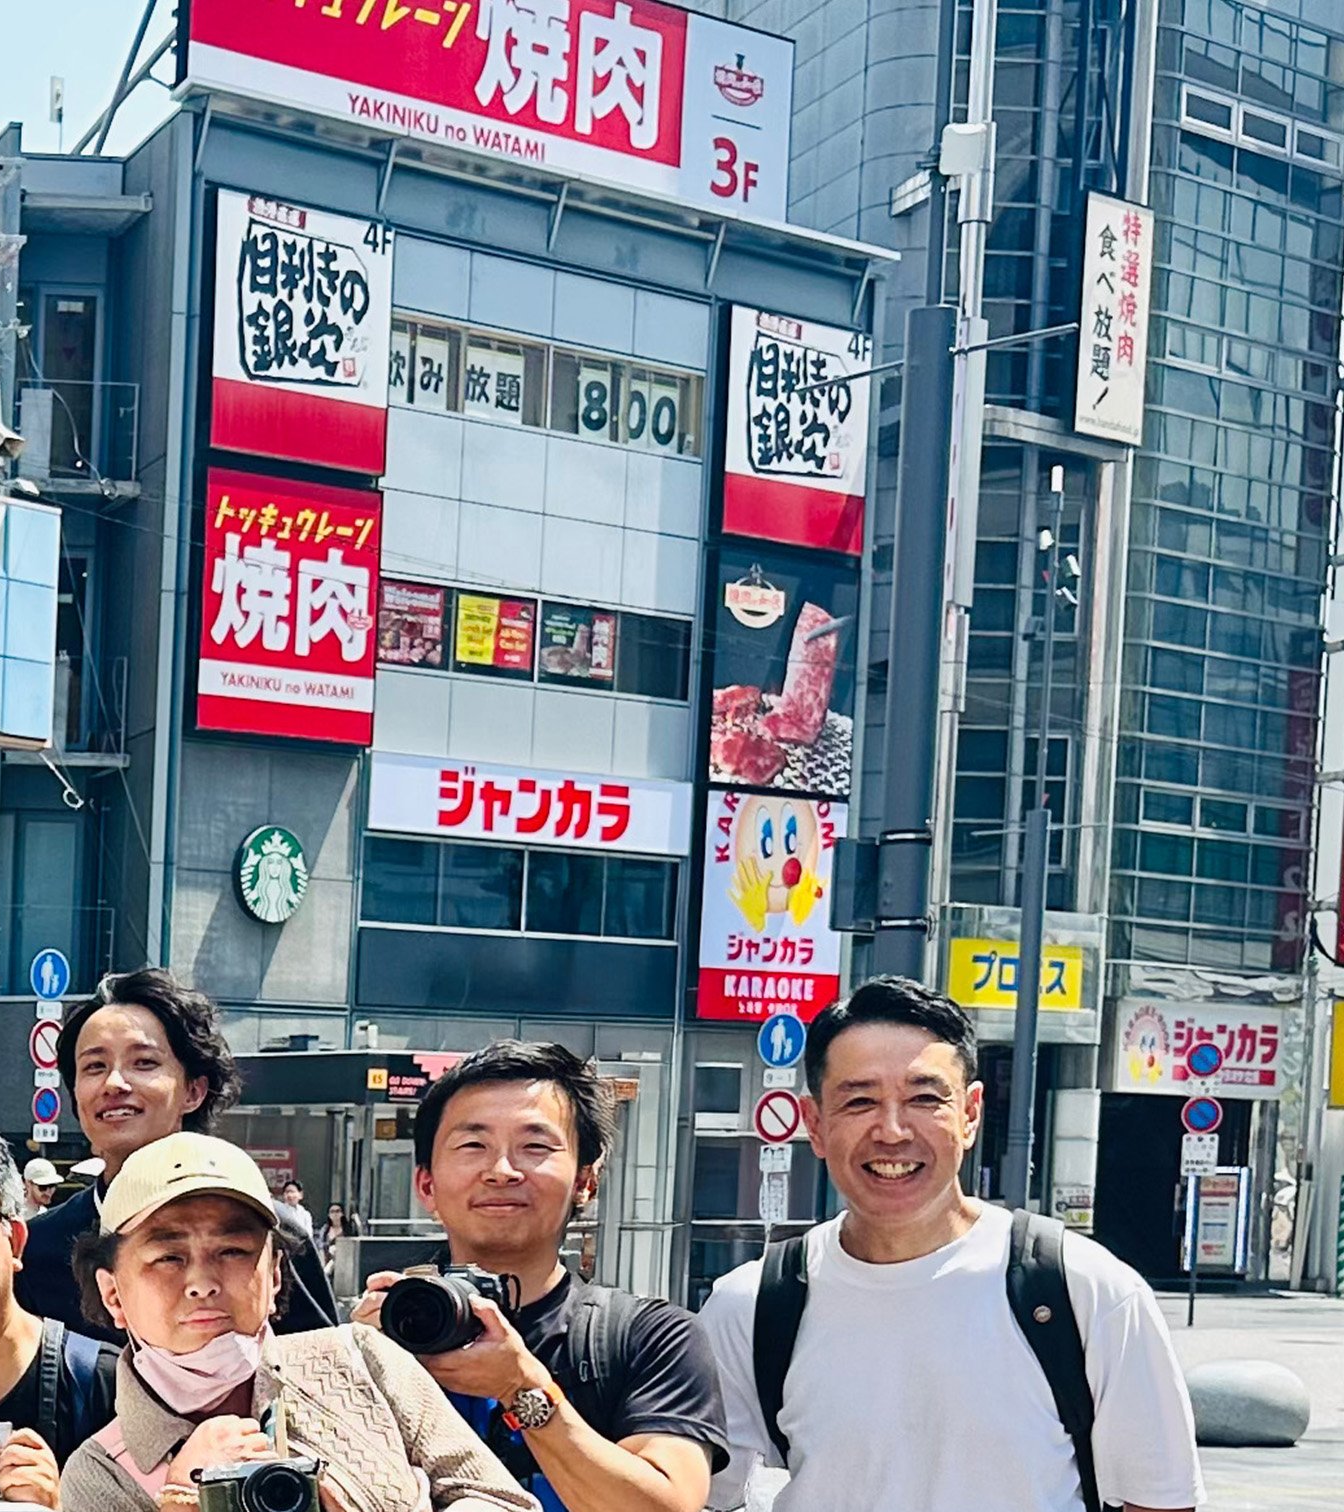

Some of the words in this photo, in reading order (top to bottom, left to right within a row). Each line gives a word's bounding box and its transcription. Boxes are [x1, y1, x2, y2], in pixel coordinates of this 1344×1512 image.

[474, 0, 664, 150] 焼肉
[348, 93, 440, 136] YAKINIKU
[445, 123, 468, 142] no
[472, 127, 547, 163] WATAMI
[710, 137, 759, 202] 3F
[363, 222, 392, 255] 4F
[244, 231, 370, 326] 目利きの
[1116, 209, 1143, 367] 特選焼肉
[245, 299, 343, 378] 銀次
[848, 332, 873, 362] 4F
[582, 380, 677, 446] 800
[210, 532, 370, 663] 焼肉
[220, 671, 282, 691] YAKINIKU
[285, 683, 301, 695] no
[304, 683, 355, 699] WATAMI
[437, 766, 631, 842] ジャンカラ
[726, 930, 815, 966] ジャンカラ
[971, 950, 1067, 996] プロス
[723, 974, 816, 1001] KARAOKE
